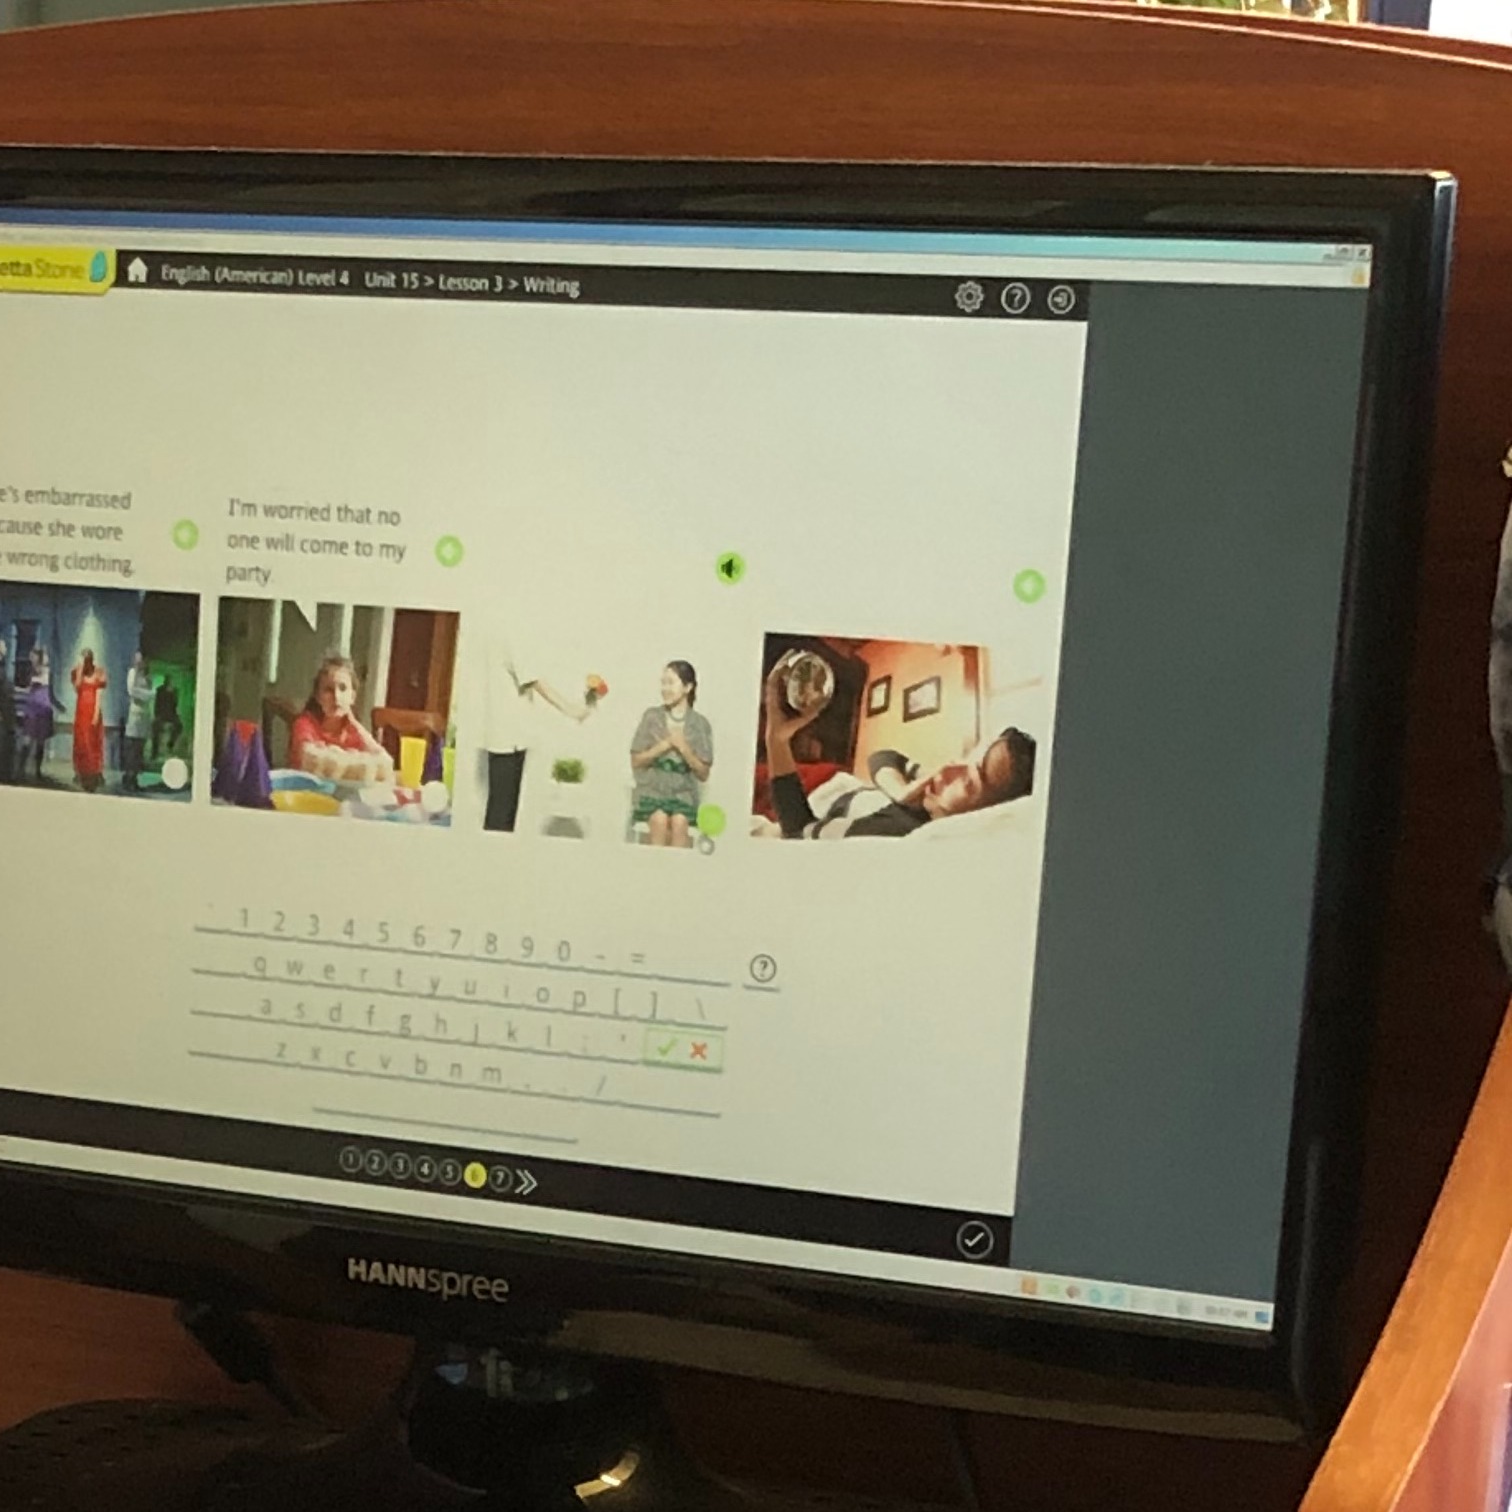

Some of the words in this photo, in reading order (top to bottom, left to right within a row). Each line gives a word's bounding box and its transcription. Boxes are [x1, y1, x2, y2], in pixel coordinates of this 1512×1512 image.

[36, 257, 85, 281] Stone
[161, 265, 210, 289] English
[214, 266, 295, 288] (American)
[298, 268, 335, 287] Level
[339, 269, 349, 286] 4
[364, 271, 396, 289] Unit
[402, 272, 419, 289] 15
[438, 273, 489, 292] Lesson
[493, 275, 503, 292] 3
[523, 276, 580, 299] Writing
[24, 487, 132, 511] embarrassed
[228, 498, 258, 517] I'm
[262, 502, 331, 522] worried
[336, 504, 372, 525] that
[377, 509, 402, 527] no
[48, 518, 76, 538] she
[81, 523, 124, 542] wore
[6, 550, 60, 573] wrong
[227, 532, 260, 550] one
[265, 532, 295, 551] will
[299, 537, 349, 556] come
[354, 539, 374, 558] to
[379, 542, 407, 564] my
[239, 908, 250, 929] 1
[273, 911, 286, 932] 2
[308, 914, 321, 936] 3
[342, 918, 356, 939] 4
[378, 921, 390, 943] 5
[413, 925, 426, 947] 6
[449, 928, 462, 950] 7
[485, 933, 498, 955] 8
[521, 936, 534, 958] 9
[557, 941, 571, 962] 0
[254, 956, 267, 978] q
[288, 960, 303, 976] w
[323, 964, 336, 980] e
[360, 967, 369, 983] r
[394, 968, 404, 988] t
[430, 976, 441, 996] y
[464, 979, 477, 995] u
[536, 986, 550, 1003] o
[573, 990, 586, 1013] p
[261, 999, 272, 1015] a
[296, 1002, 306, 1019] s
[329, 1002, 342, 1023] d
[365, 1004, 376, 1027] f
[400, 1014, 412, 1037] g
[435, 1013, 448, 1035] h
[507, 1020, 519, 1043] k
[276, 1043, 287, 1058] z
[311, 1046, 322, 1062] x
[345, 1051, 356, 1067] c
[380, 1055, 391, 1071] v
[415, 1053, 428, 1075] b
[449, 1062, 463, 1079] n
[482, 1065, 502, 1083] m
[347, 1257, 510, 1303] HANNspree
